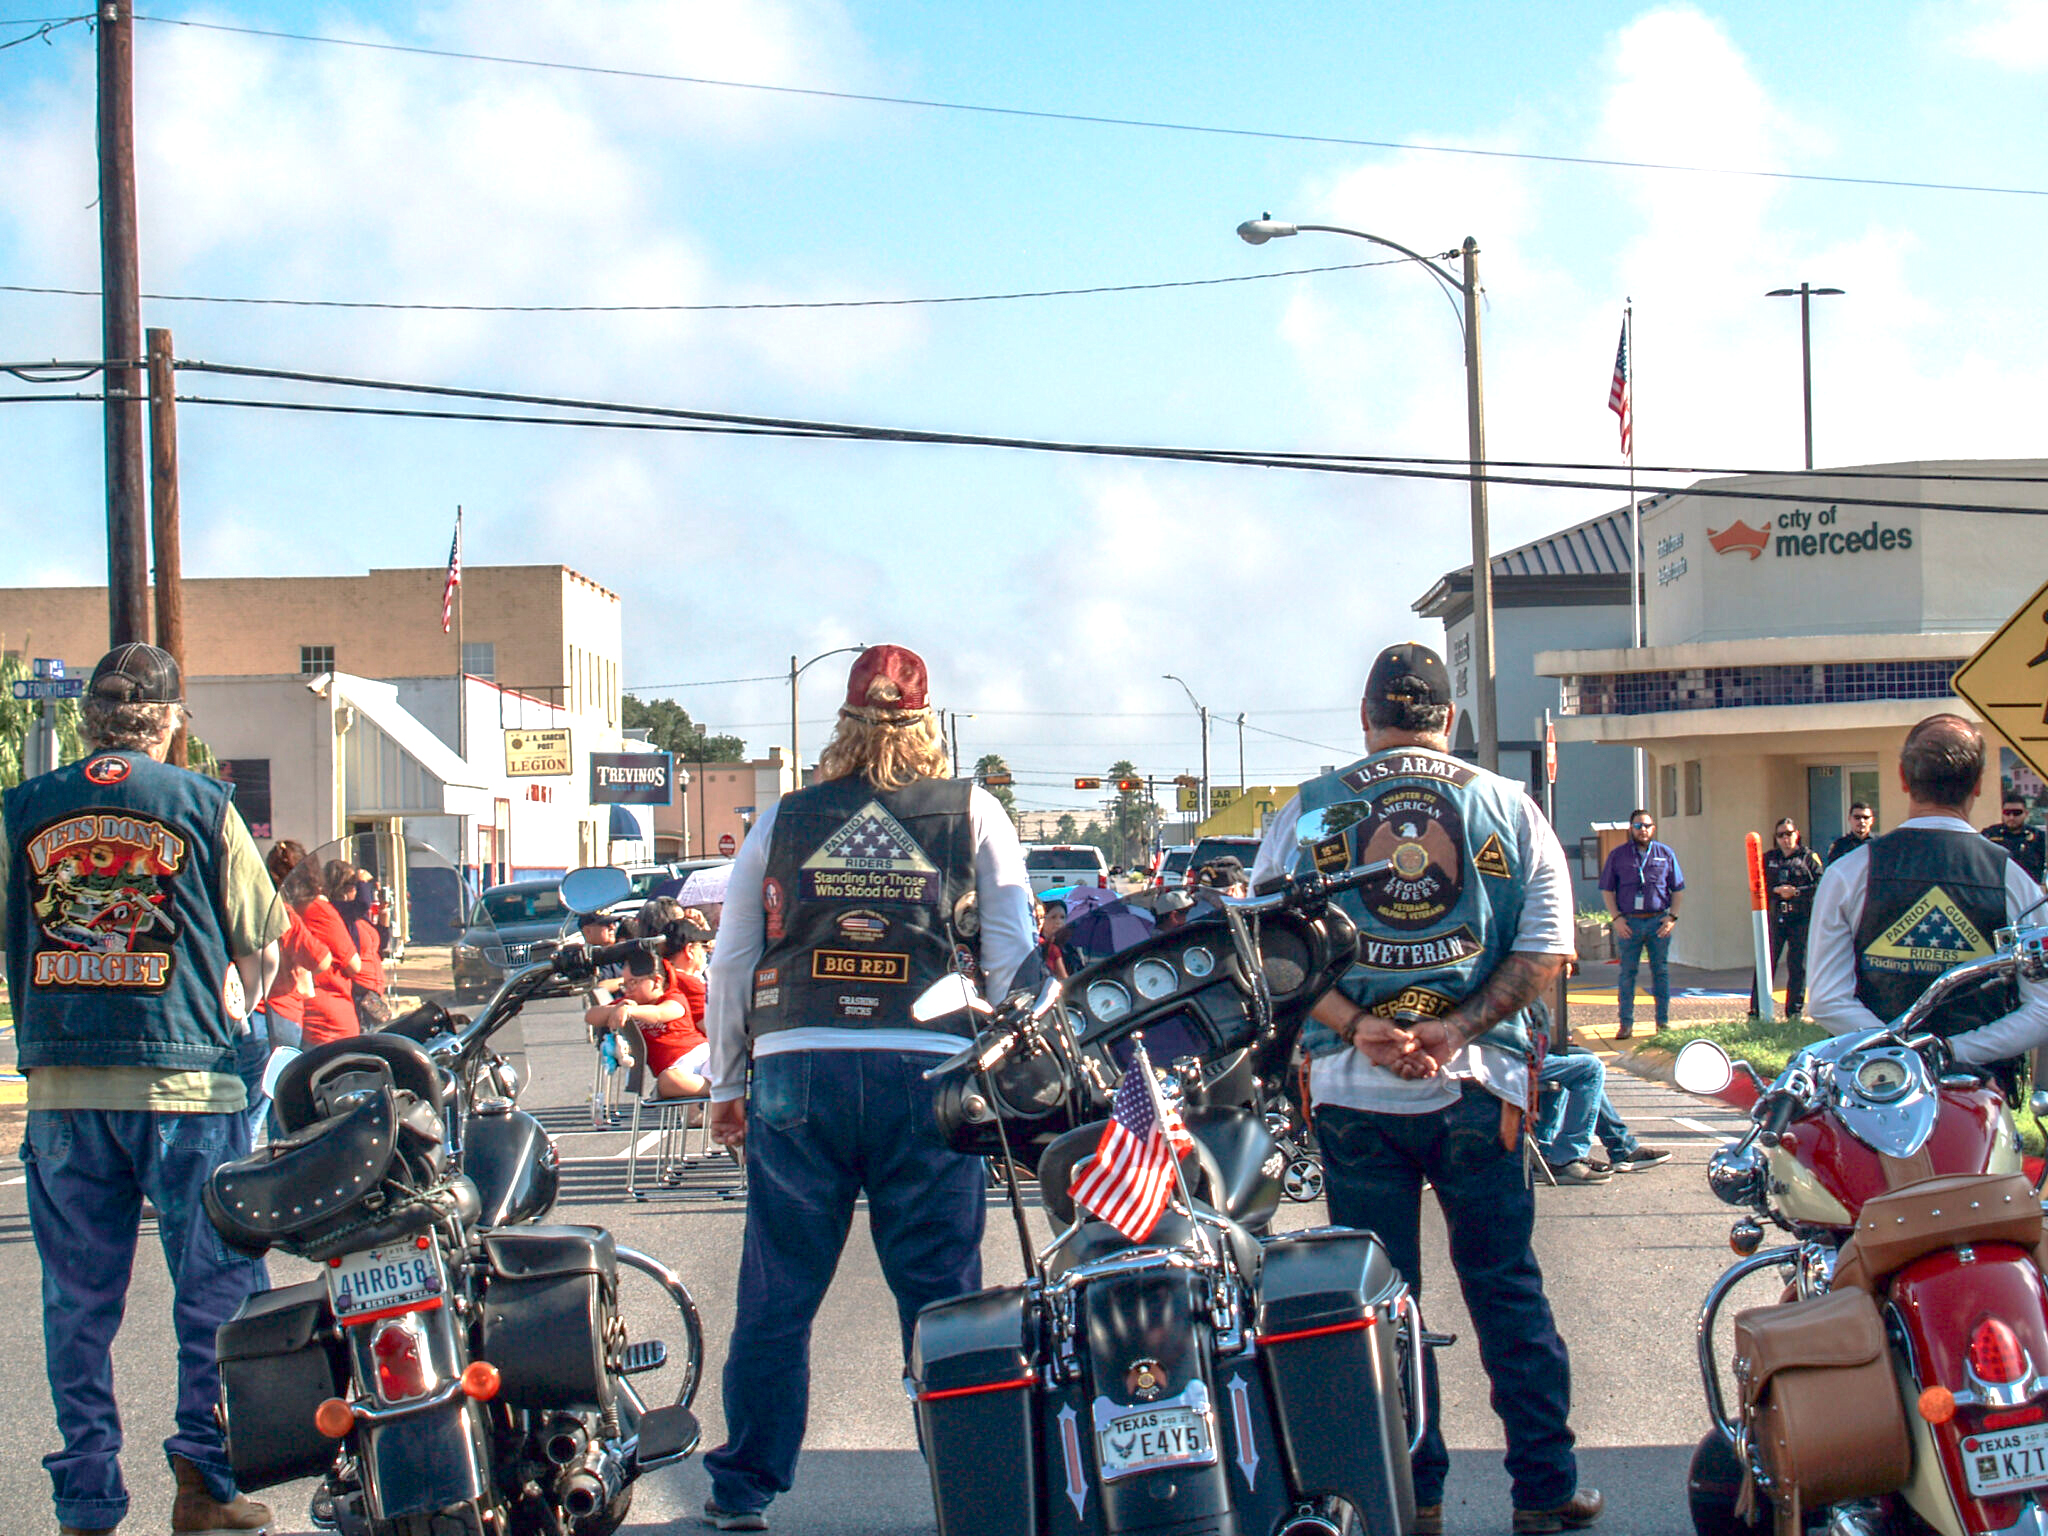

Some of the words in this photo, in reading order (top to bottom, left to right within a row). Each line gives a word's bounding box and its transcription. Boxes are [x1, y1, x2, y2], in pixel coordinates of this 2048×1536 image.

[1778, 509, 1811, 531] city
[1818, 505, 1837, 525] of
[1776, 521, 1913, 558] mercedes
[510, 758, 567, 772] LEGION
[1357, 763, 1394, 783] U.S.
[1400, 757, 1460, 778] ARMY
[1382, 792, 1421, 805] CHAPTER
[1378, 801, 1443, 822] AMERICAN
[824, 812, 866, 853] PATRIOT
[882, 816, 914, 853] GUARD
[29, 817, 96, 873] VETS
[100, 816, 182, 870] DON'T
[845, 859, 893, 869] RIDERS
[814, 871, 866, 886] Standing
[869, 871, 887, 885] for
[888, 872, 927, 887] Those
[1389, 876, 1434, 892] LEGION
[815, 884, 843, 897] Who
[845, 884, 880, 898] Stood
[882, 886, 901, 899] for
[903, 887, 922, 900] US
[1384, 882, 1441, 900] RIDERS
[1885, 898, 1931, 942] PATRIOT
[1945, 905, 1979, 944] GUARD
[1367, 936, 1464, 965] VETERAN
[1910, 948, 1958, 961] RIDERS
[37, 952, 168, 984] FORGET
[824, 957, 855, 973] BIG
[860, 958, 897, 974] RED
[1914, 961, 1942, 971] With
[839, 996, 879, 1007] CRASHING
[844, 1006, 872, 1016] SUCKS
[340, 1259, 427, 1296] 4HR658
[1112, 1414, 1158, 1434] TEXAS
[1140, 1427, 1200, 1457] E4Y5
[1977, 1435, 2021, 1453] TEXAS
[2002, 1447, 2045, 1477] K7T
